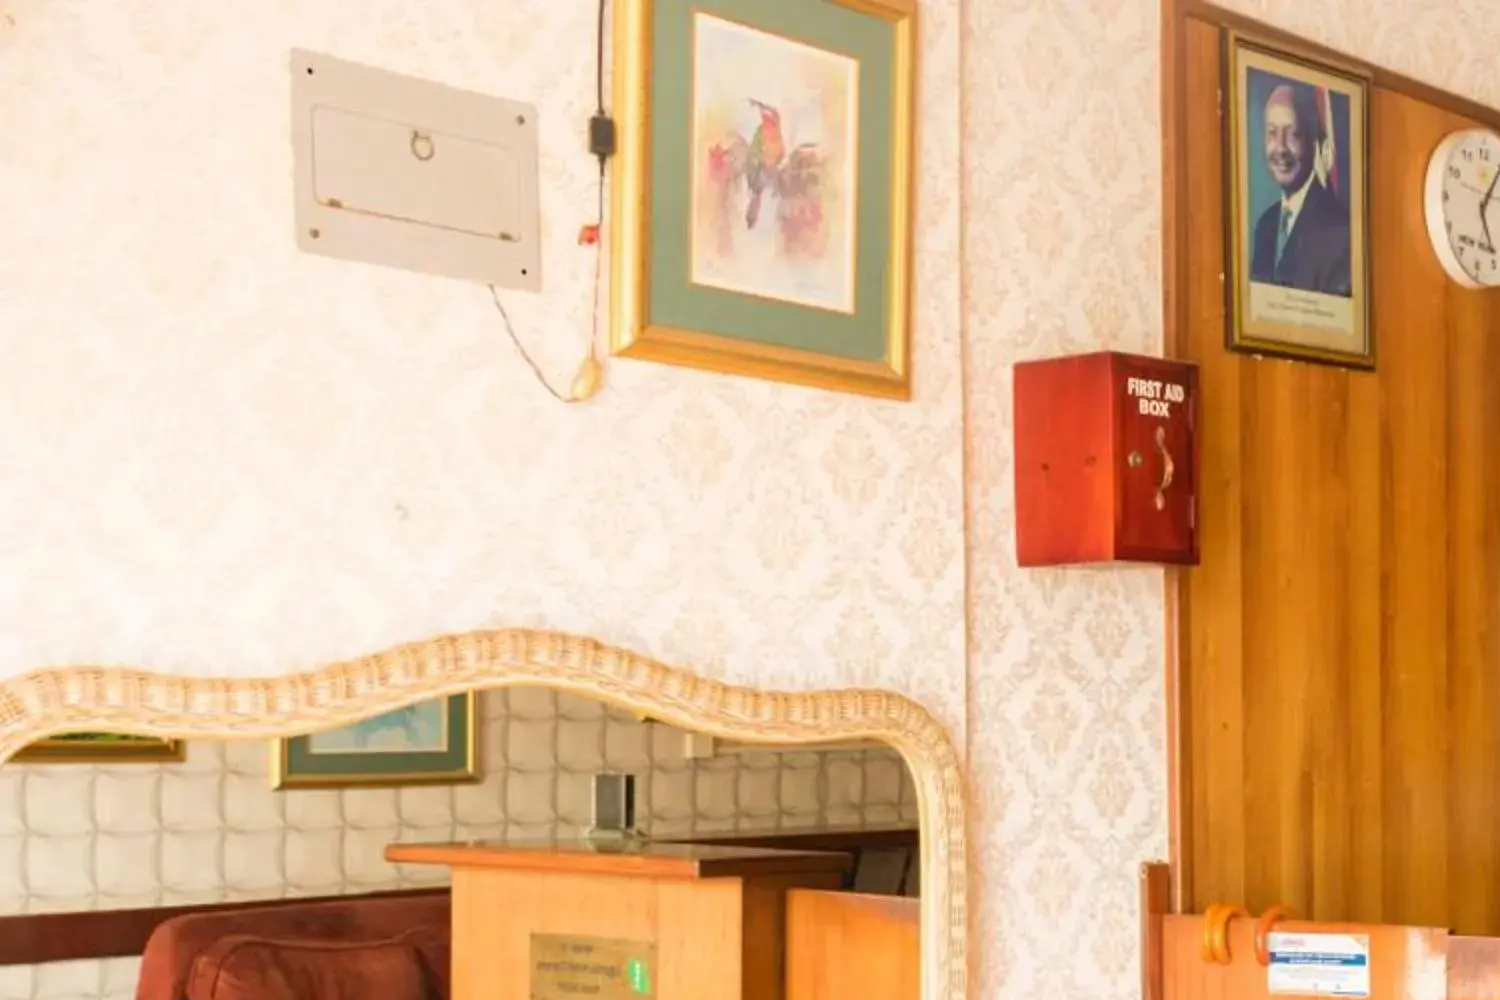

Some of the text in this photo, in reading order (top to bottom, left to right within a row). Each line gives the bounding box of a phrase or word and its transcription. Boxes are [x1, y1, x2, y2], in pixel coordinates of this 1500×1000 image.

[1127, 378, 1184, 403] FIRST AID
[1138, 398, 1170, 417] BOX
